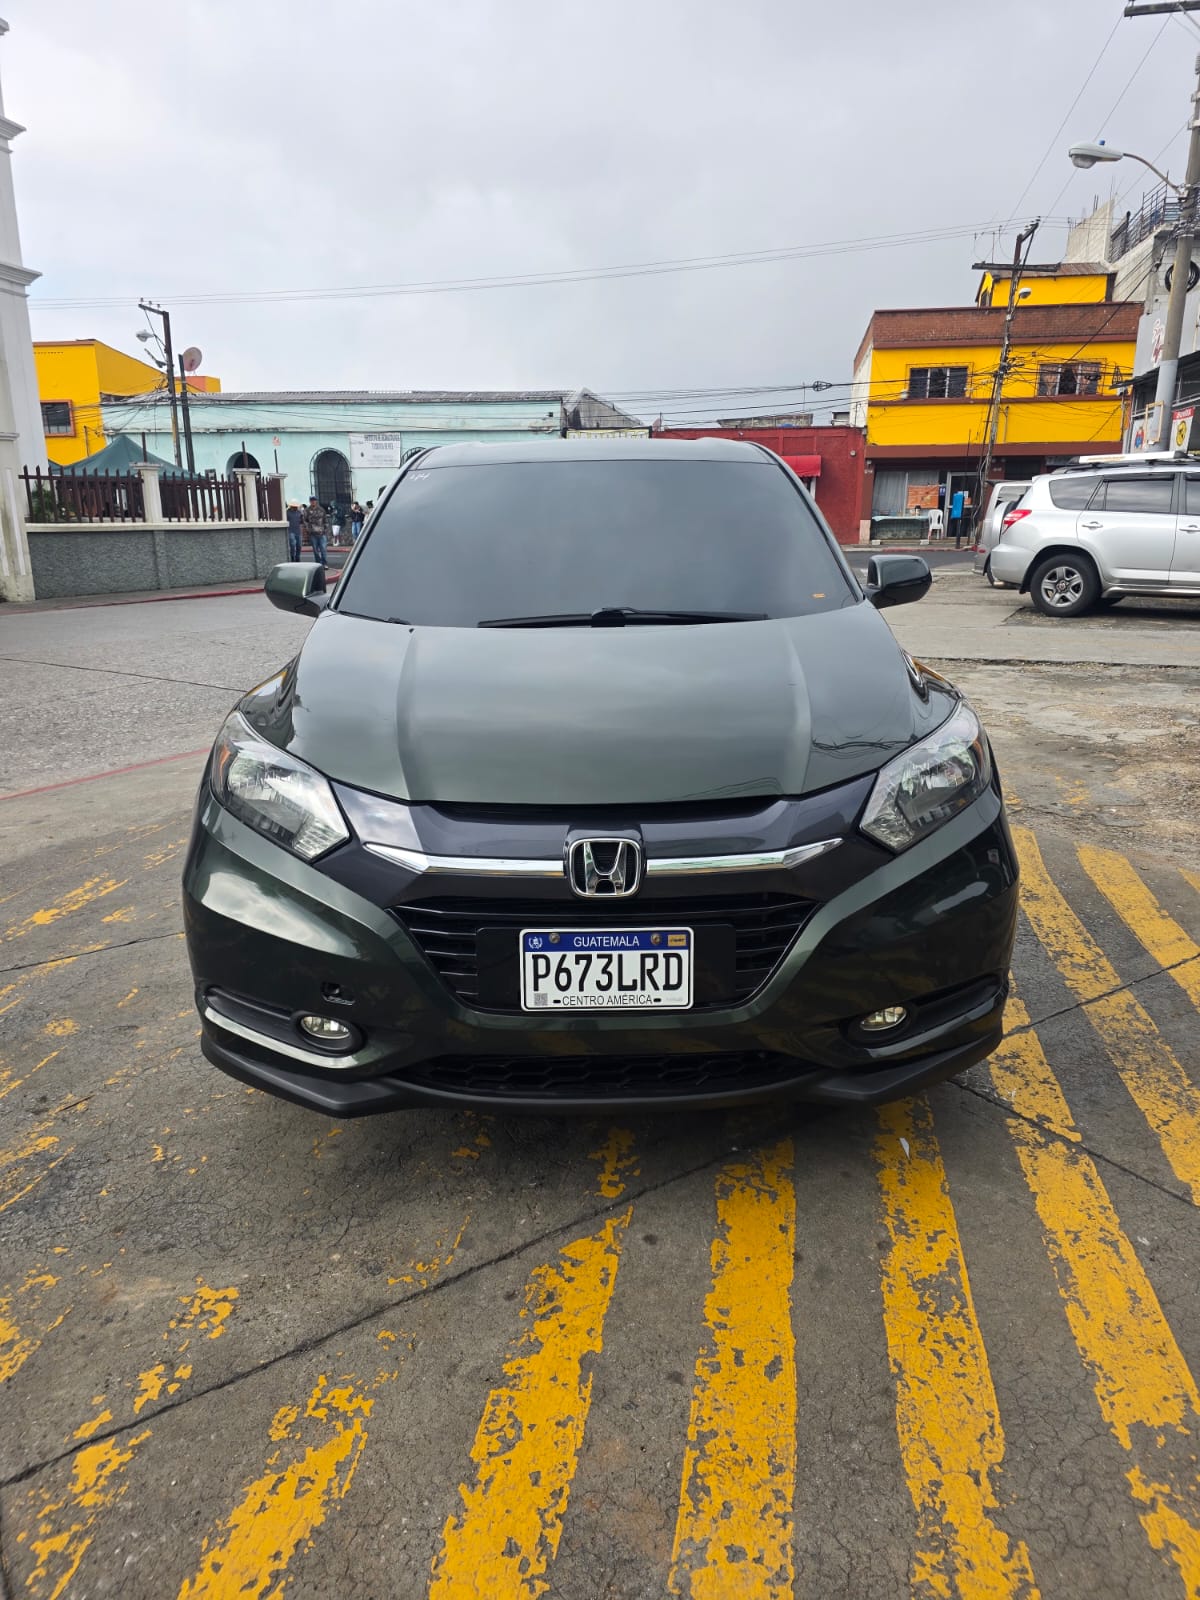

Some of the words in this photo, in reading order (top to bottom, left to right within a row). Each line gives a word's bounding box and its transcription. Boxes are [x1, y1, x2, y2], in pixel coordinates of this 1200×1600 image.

[573, 936, 640, 948] GUATEMALA
[531, 952, 683, 992] P673LRD
[562, 995, 605, 1006] CENTRO
[606, 992, 653, 1006] AMÉRICA
